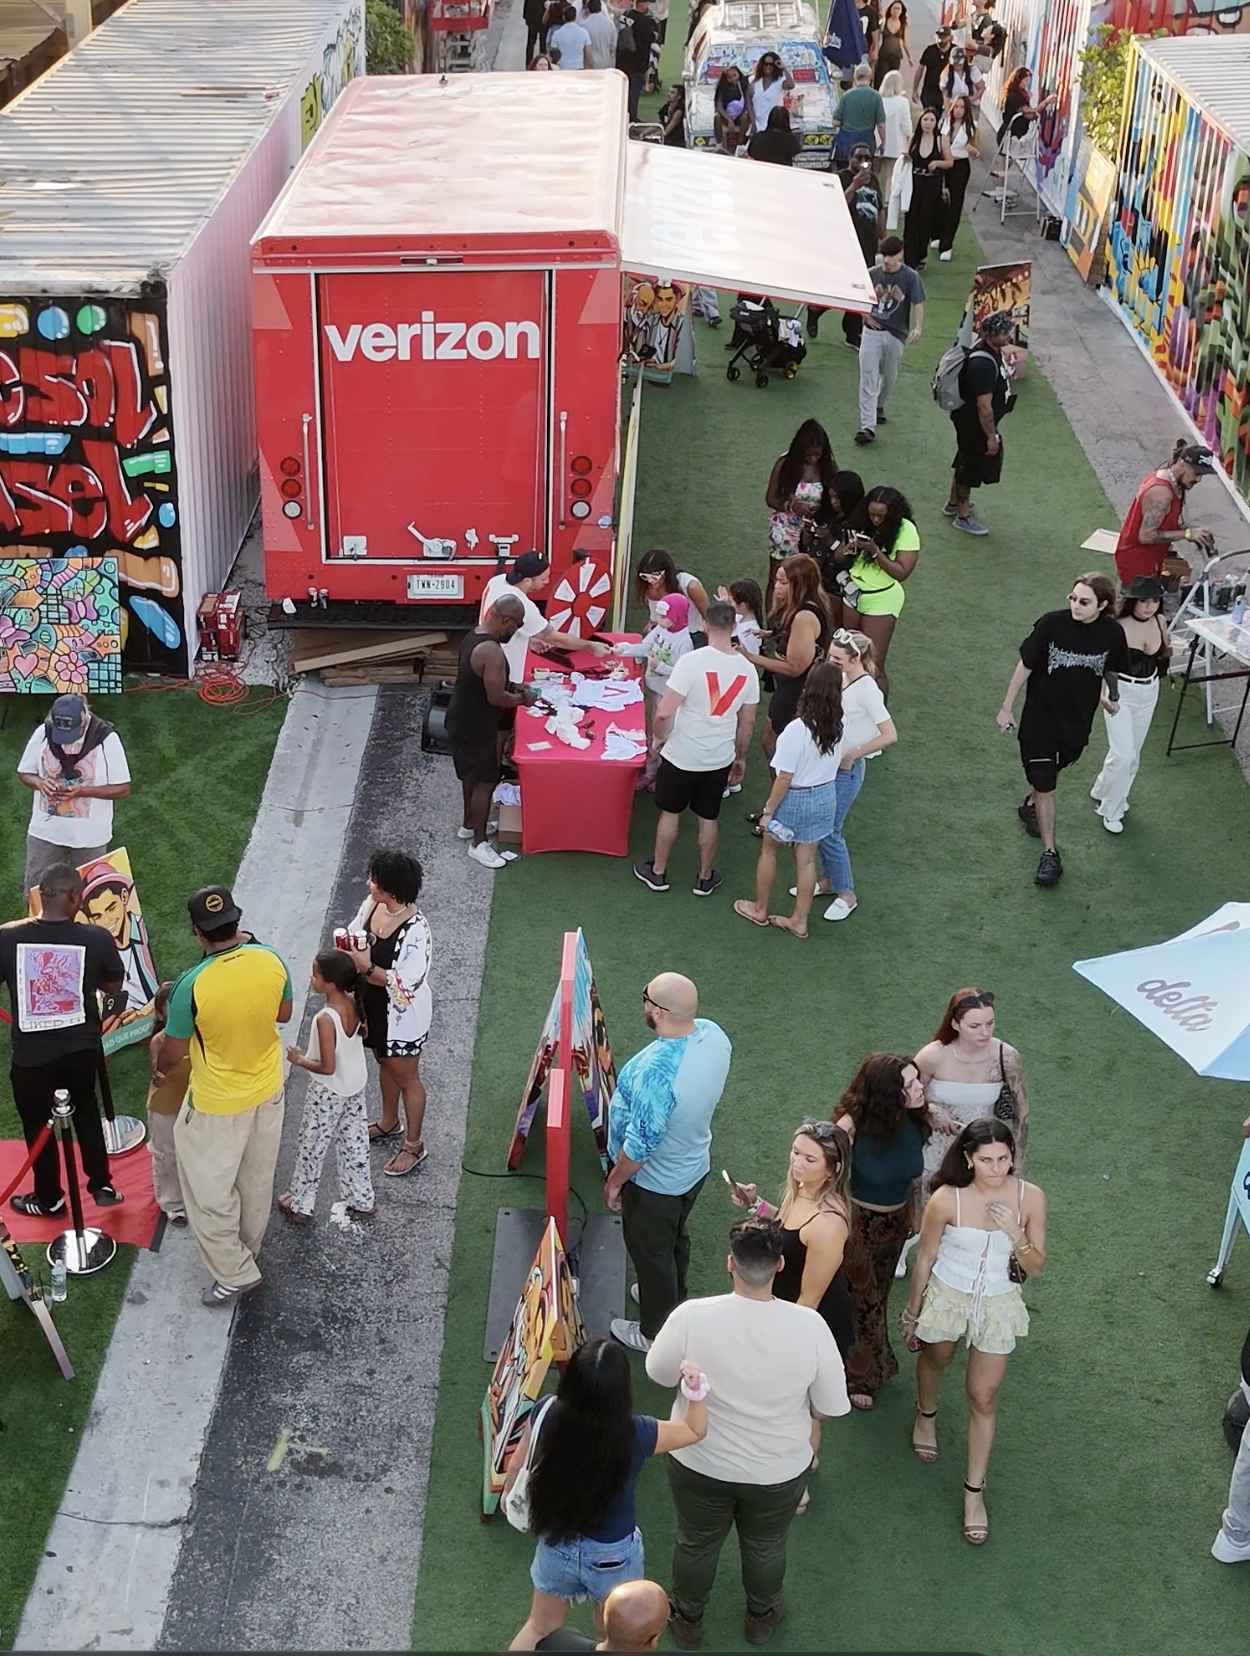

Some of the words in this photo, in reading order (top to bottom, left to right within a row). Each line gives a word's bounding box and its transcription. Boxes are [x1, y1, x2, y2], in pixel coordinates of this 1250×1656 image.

[324, 310, 541, 362] verizon
[705, 670, 748, 718] V
[115, 1031, 130, 1045] QUE
